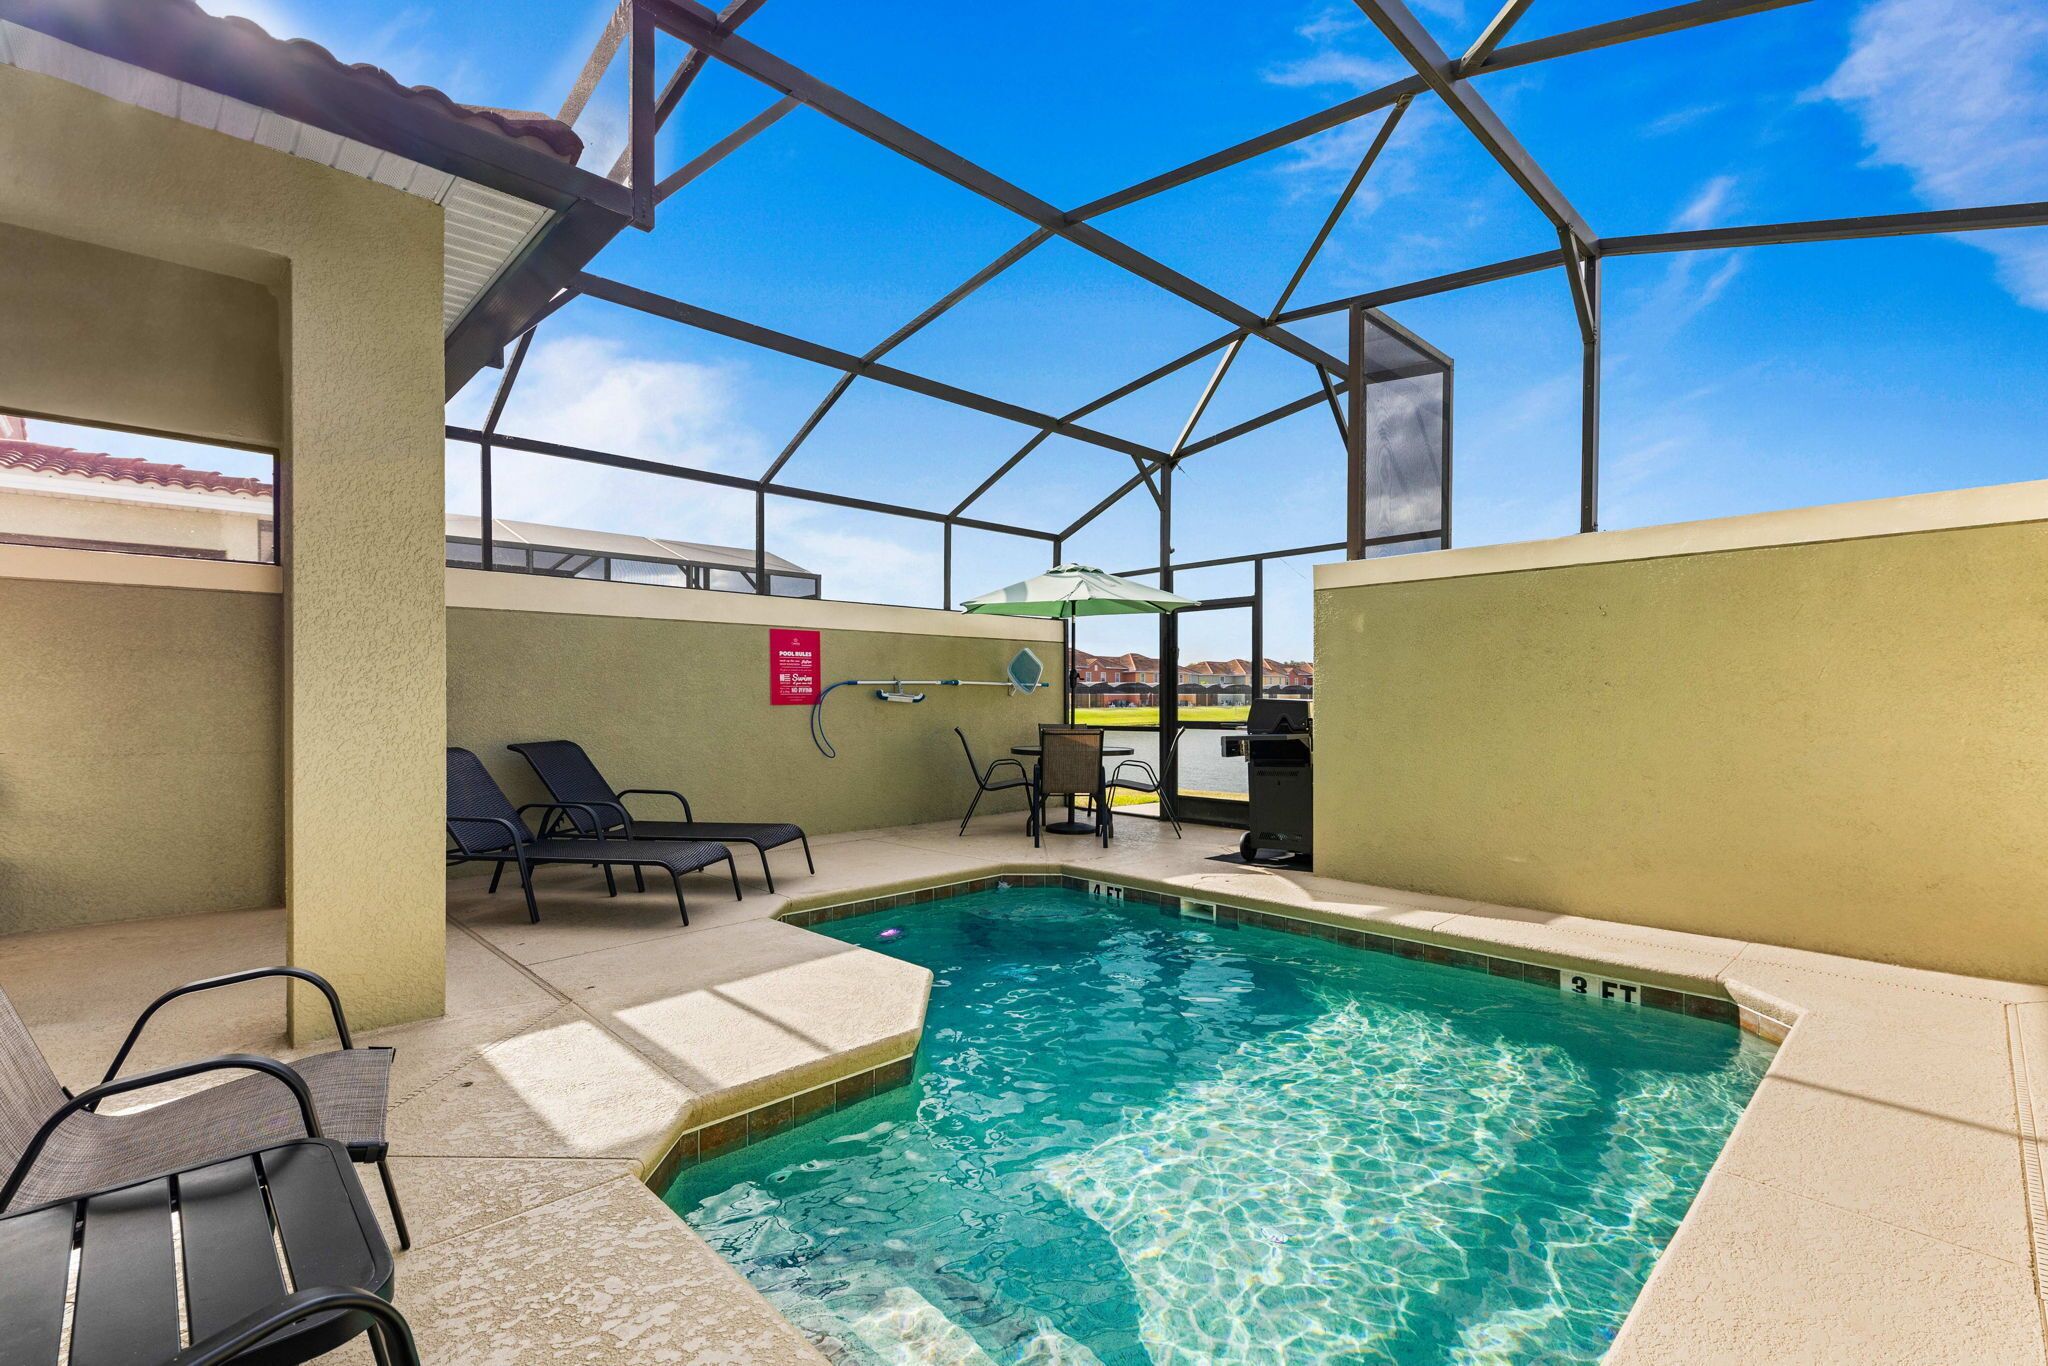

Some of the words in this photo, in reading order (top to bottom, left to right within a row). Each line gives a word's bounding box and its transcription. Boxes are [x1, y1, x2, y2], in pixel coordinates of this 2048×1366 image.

[1093, 884, 1100, 895] 4
[1107, 886, 1122, 899] FT
[1571, 976, 1587, 994] 3
[1602, 981, 1637, 1003] FT
